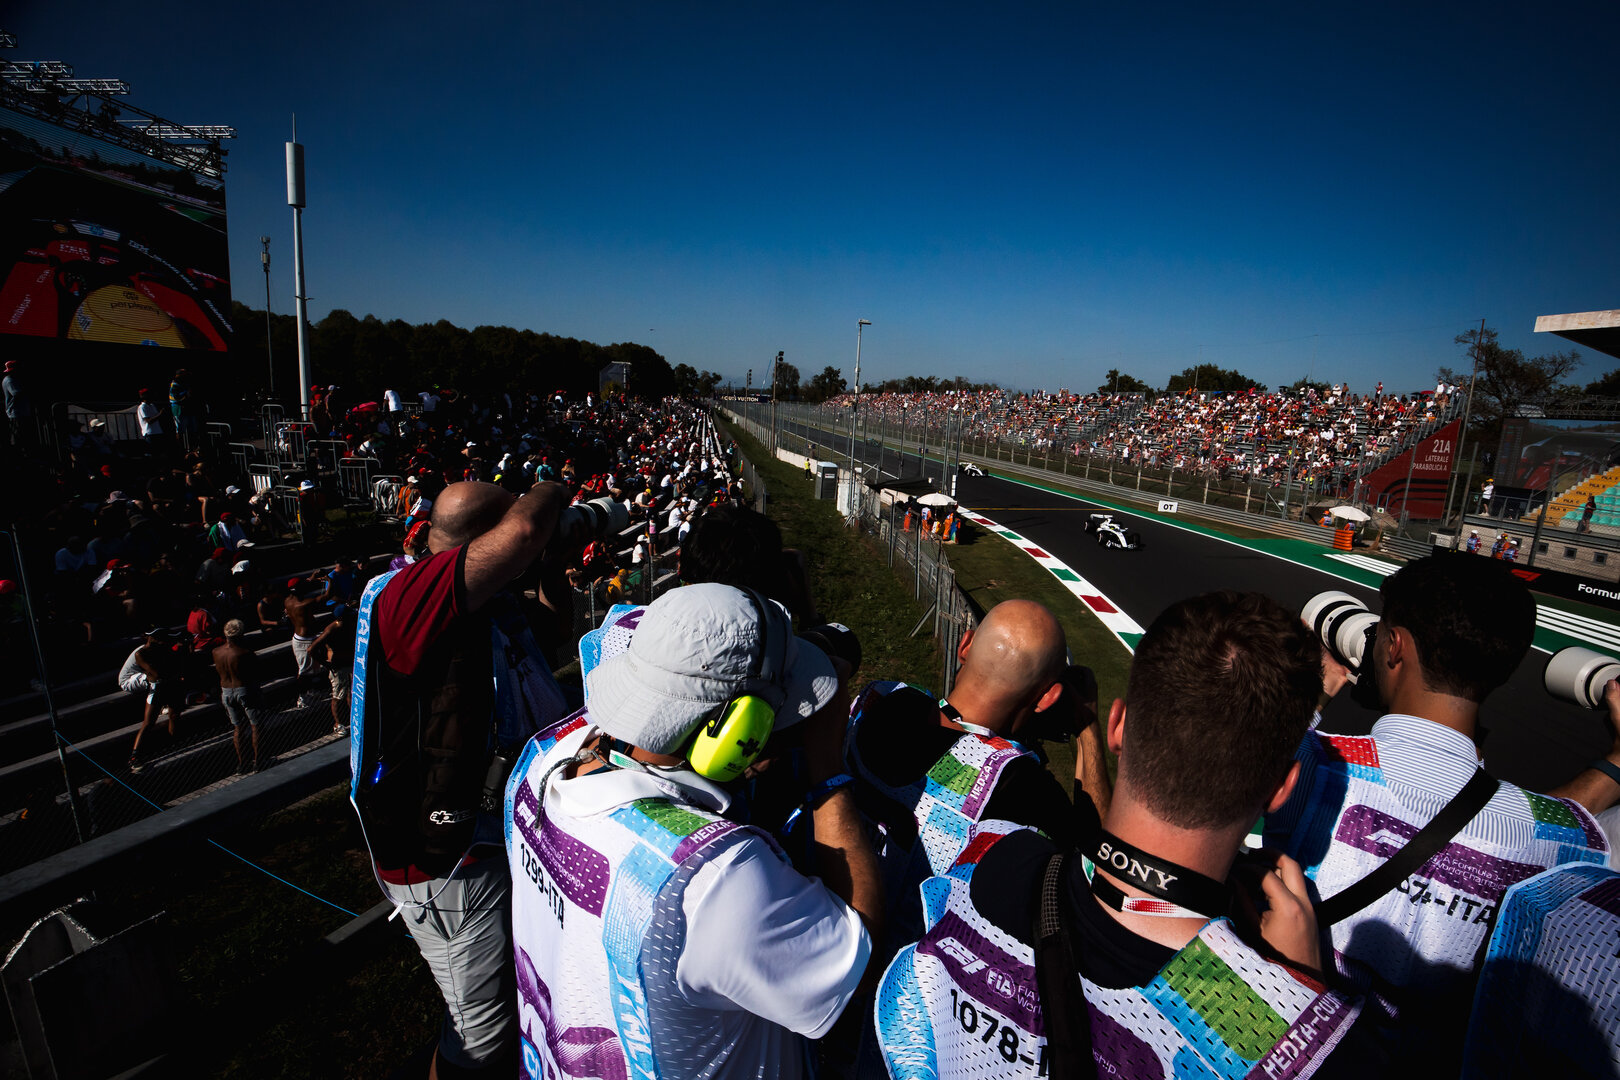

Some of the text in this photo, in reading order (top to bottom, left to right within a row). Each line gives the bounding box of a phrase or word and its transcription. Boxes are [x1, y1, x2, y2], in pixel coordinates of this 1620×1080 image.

[1433, 439, 1450, 453] 21A
[1424, 454, 1450, 463] LATERALE
[1412, 462, 1442, 471] PARABOLICA
[1163, 503, 1174, 511] OT
[1096, 841, 1178, 891] SONY
[520, 843, 565, 930] 1299-ITA
[1017, 985, 1035, 999] FIA
[1017, 994, 1042, 1015] Worl
[951, 988, 1049, 1078] 1078-I
